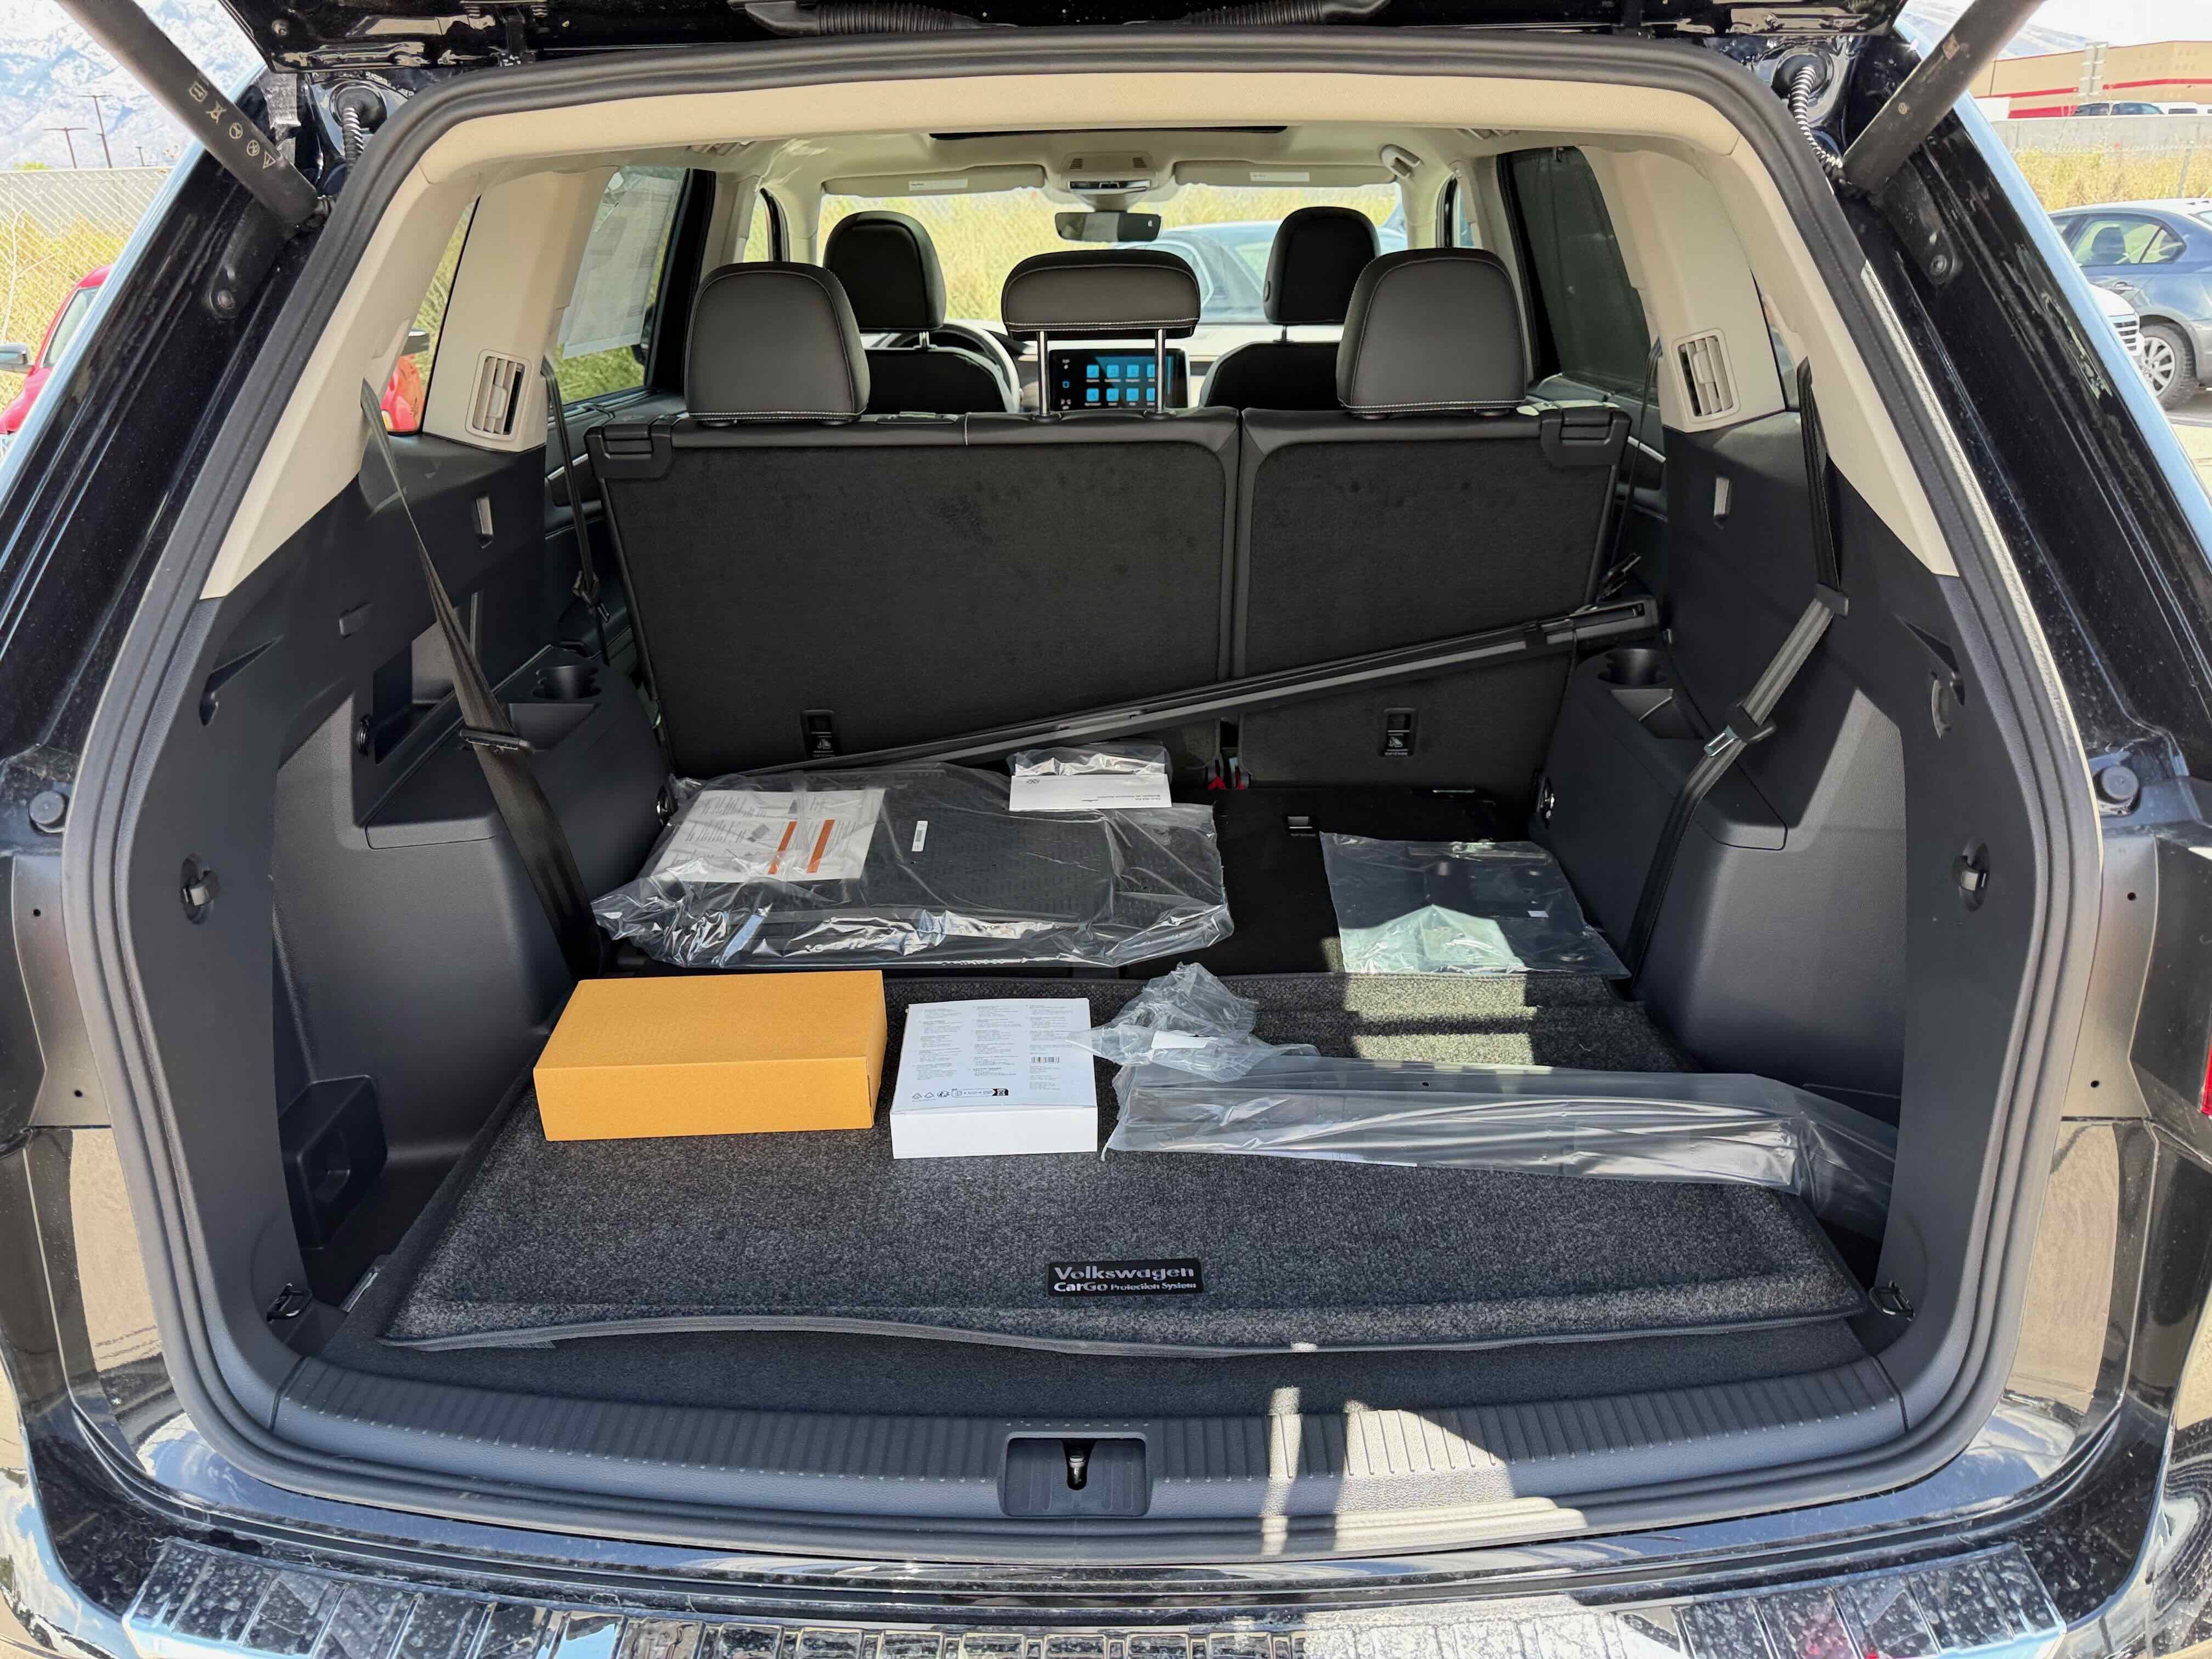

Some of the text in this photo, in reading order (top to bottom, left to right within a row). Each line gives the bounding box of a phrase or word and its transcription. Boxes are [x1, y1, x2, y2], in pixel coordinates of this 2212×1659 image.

[1053, 1266, 1194, 1281] Volkswagen
[1053, 1282, 1197, 1292] CarGo Protection System
